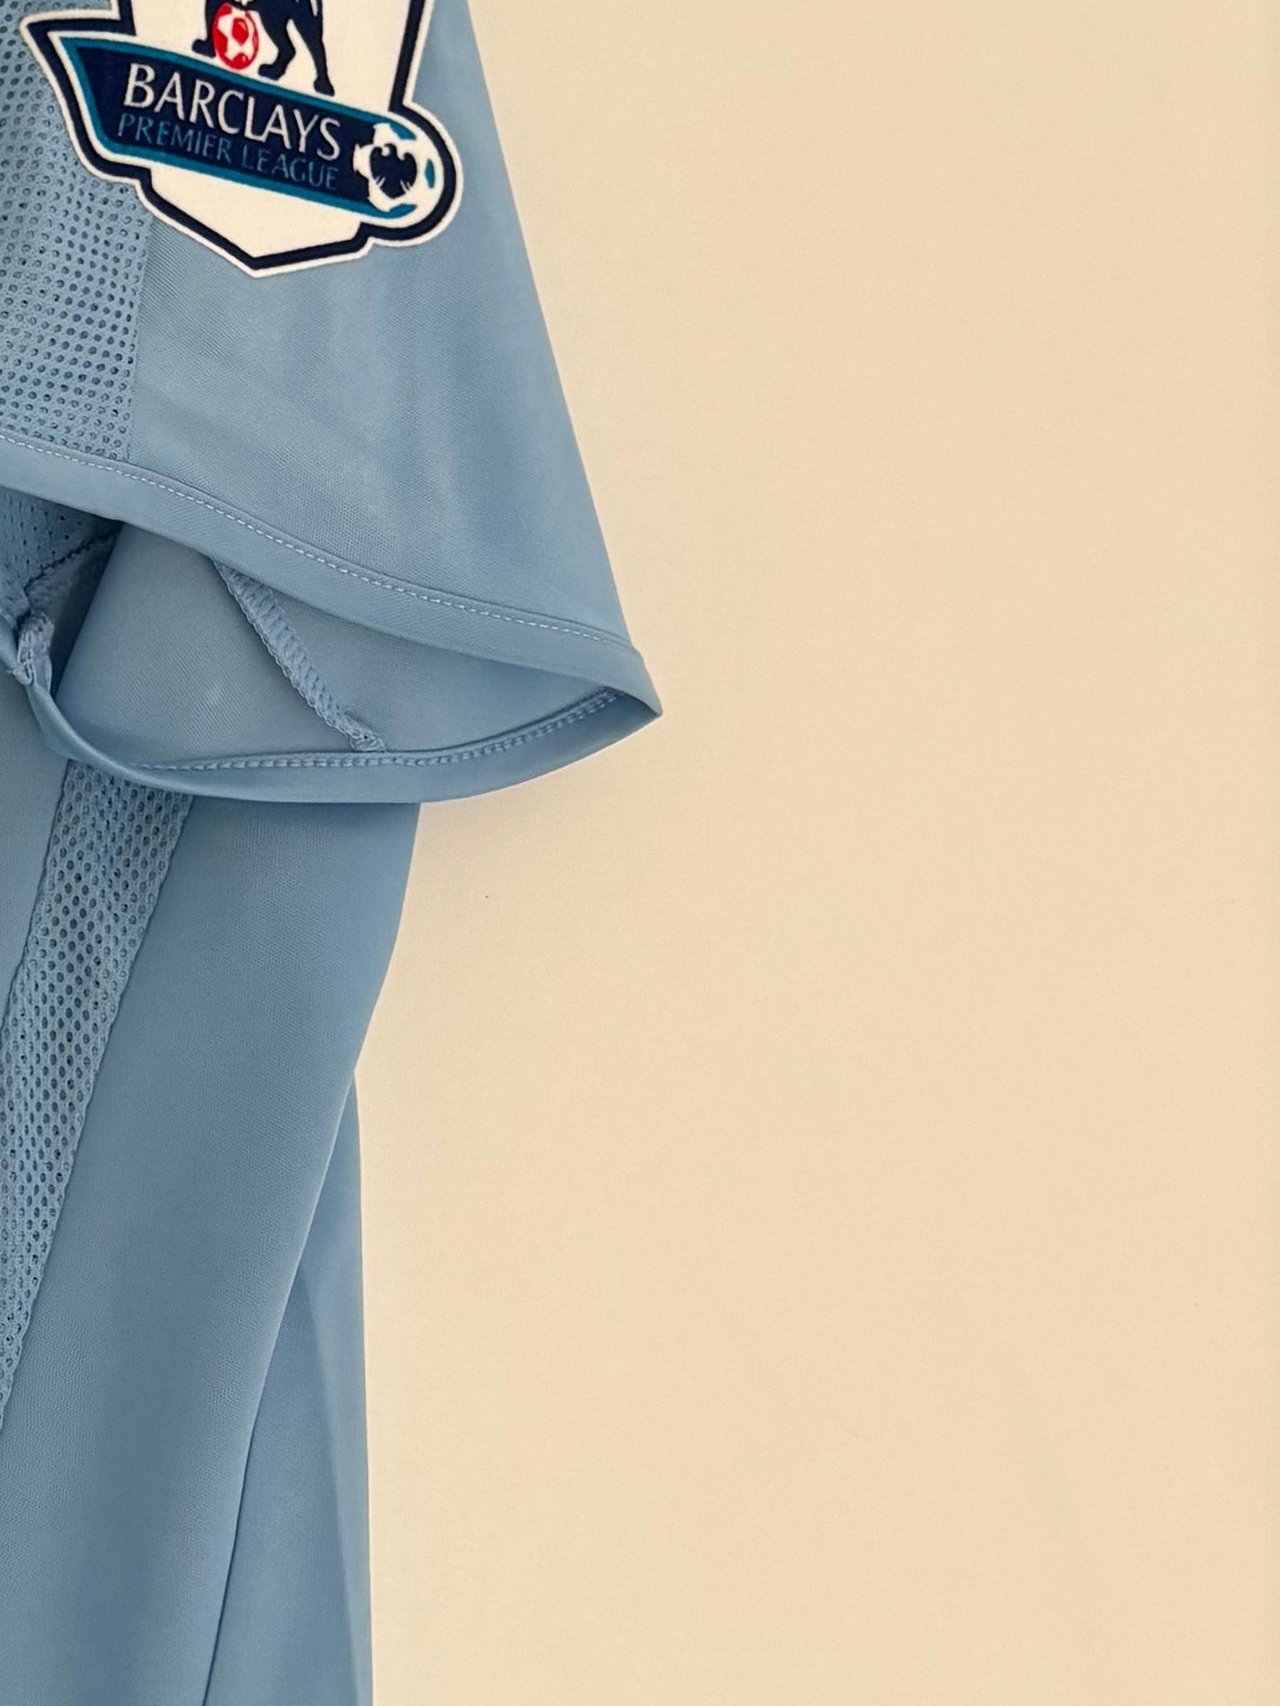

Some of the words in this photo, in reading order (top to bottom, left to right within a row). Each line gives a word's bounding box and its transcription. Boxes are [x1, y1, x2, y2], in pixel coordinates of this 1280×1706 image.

[117, 113, 233, 163] PREMIER
[242, 145, 340, 191] LEAGUE
[125, 63, 341, 162] BARCLAYS
